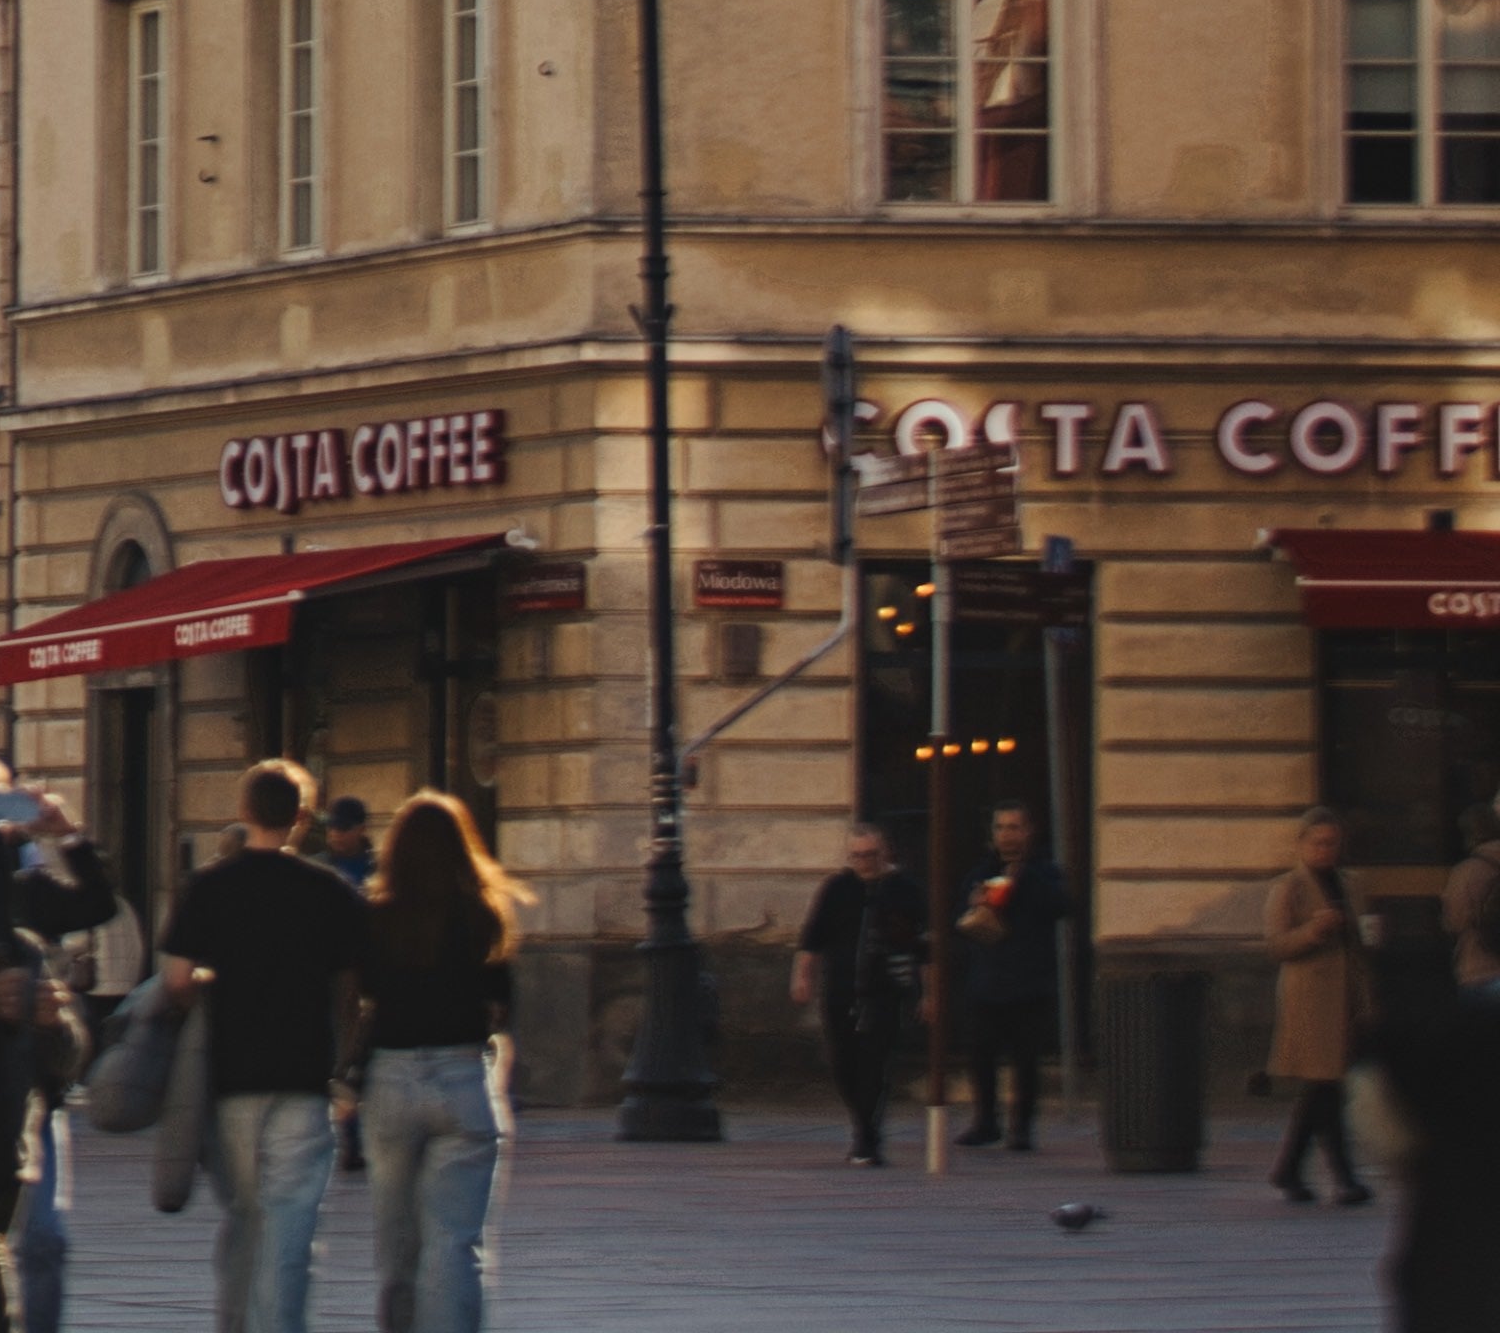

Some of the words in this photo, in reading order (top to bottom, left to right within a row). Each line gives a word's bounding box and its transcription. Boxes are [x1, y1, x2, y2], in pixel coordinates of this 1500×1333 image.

[1216, 398, 1500, 473] COFF
[219, 430, 345, 513] COSTA
[352, 410, 502, 493] COFFEE
[698, 570, 778, 590] Miodowa
[175, 622, 208, 647] COSTA
[209, 613, 252, 640] COFFEE
[29, 643, 61, 669] COSTA
[63, 638, 101, 664] COFFEE
